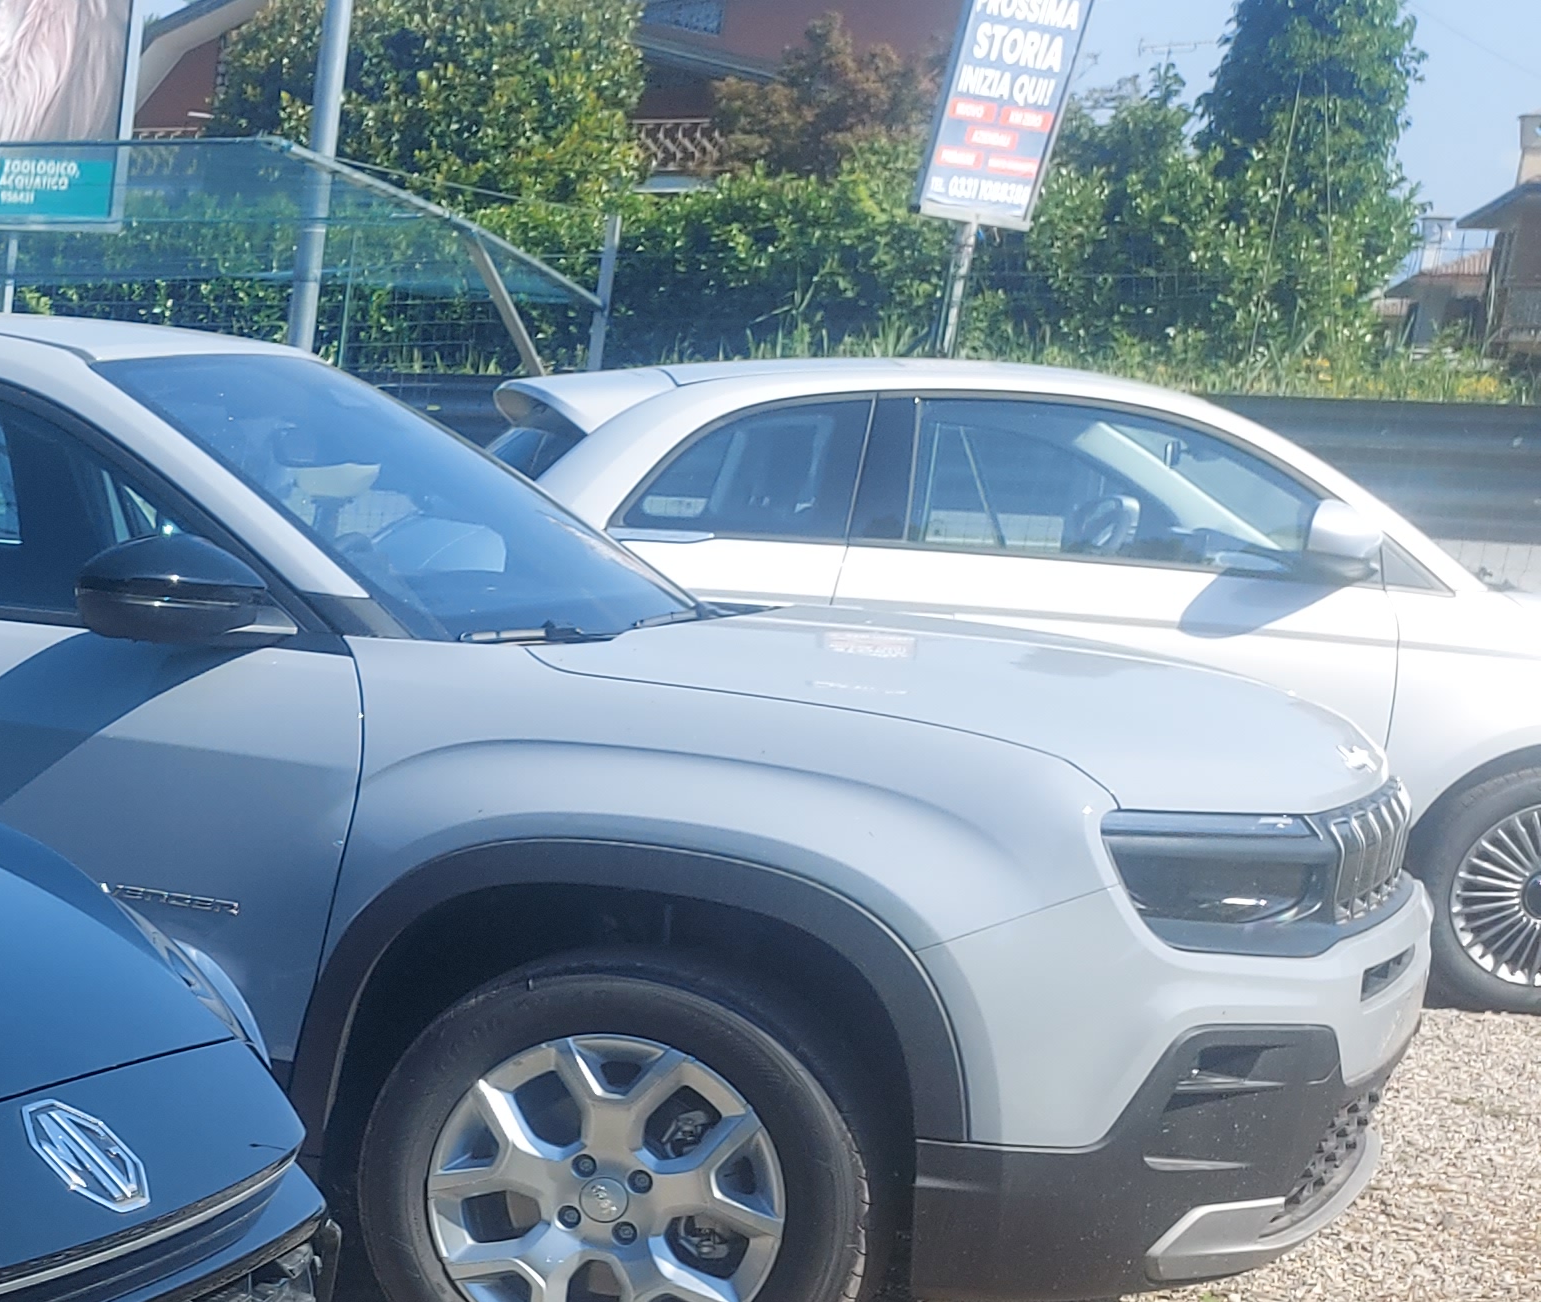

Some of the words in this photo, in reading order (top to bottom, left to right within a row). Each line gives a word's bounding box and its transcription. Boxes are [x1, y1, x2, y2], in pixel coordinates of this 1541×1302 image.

[973, 22, 1063, 73] STORIA
[957, 64, 1011, 100] INIZIA
[1013, 74, 1056, 106] QUI!
[0, 174, 69, 190] ACQUATICO
[4, 159, 80, 178] ZOOLOGICO,
[99, 881, 240, 916] VENGER
[29, 1104, 143, 1204] MG
